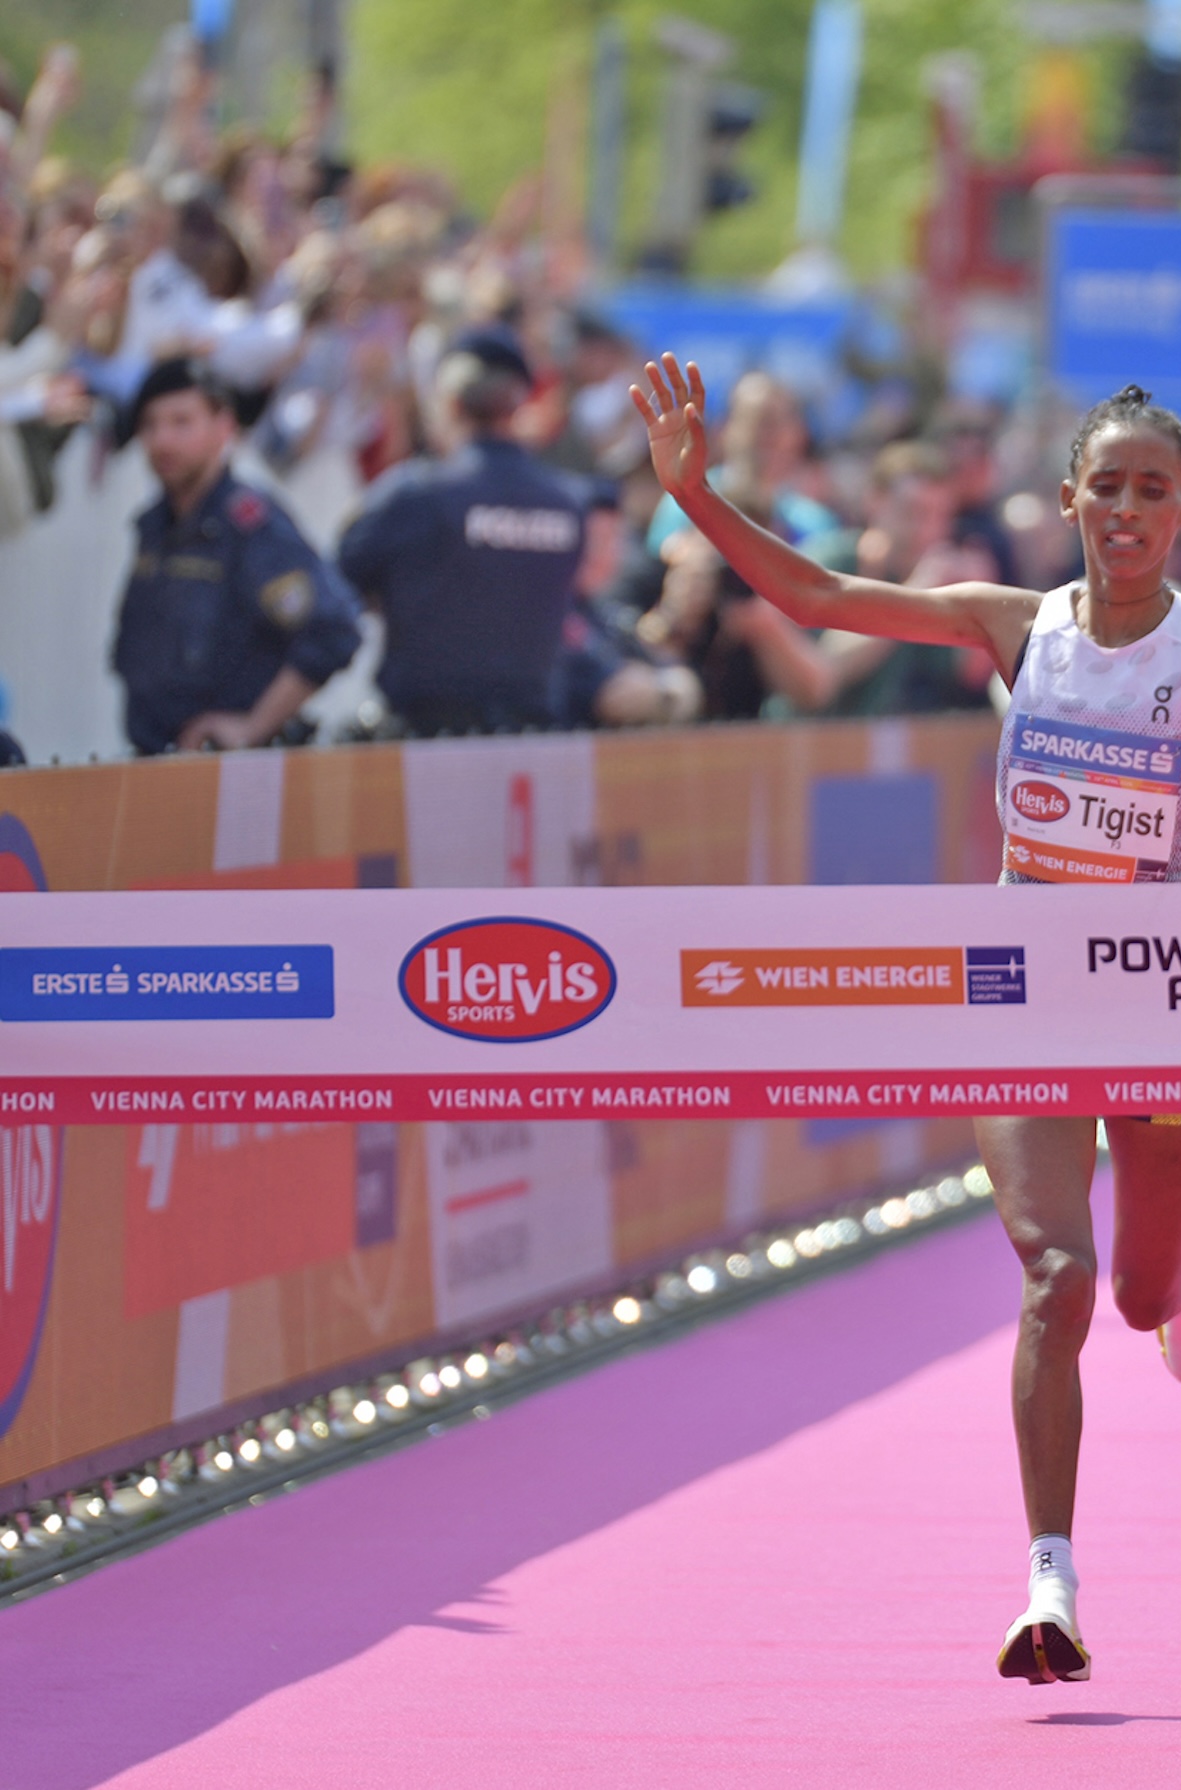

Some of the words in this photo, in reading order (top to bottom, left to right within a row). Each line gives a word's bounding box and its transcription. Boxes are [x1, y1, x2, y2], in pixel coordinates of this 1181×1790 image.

[1020, 730, 1147, 771] SPARKASSE
[1016, 786, 1065, 815] Hervis
[1079, 794, 1164, 840] Tigist
[1034, 854, 1063, 871] WIEN
[1066, 859, 1128, 880] ENERGIE
[33, 972, 103, 995] ERSTE
[138, 970, 273, 994] SPARKASSE
[424, 947, 598, 1015] Hervis
[755, 967, 828, 988] WIEN
[836, 965, 951, 987] ENERGIE
[447, 1005, 515, 1022] SPORTS
[91, 1091, 184, 1111] VIENNA
[192, 1090, 246, 1110] CITY
[255, 1089, 392, 1110] MARATHON
[429, 1088, 521, 1108] VIENNA
[529, 1087, 583, 1108] CITY
[593, 1086, 730, 1108] MARATHON
[766, 1085, 860, 1106] VIENNA
[867, 1084, 922, 1105] CITY
[930, 1083, 1068, 1104] MARATHON
